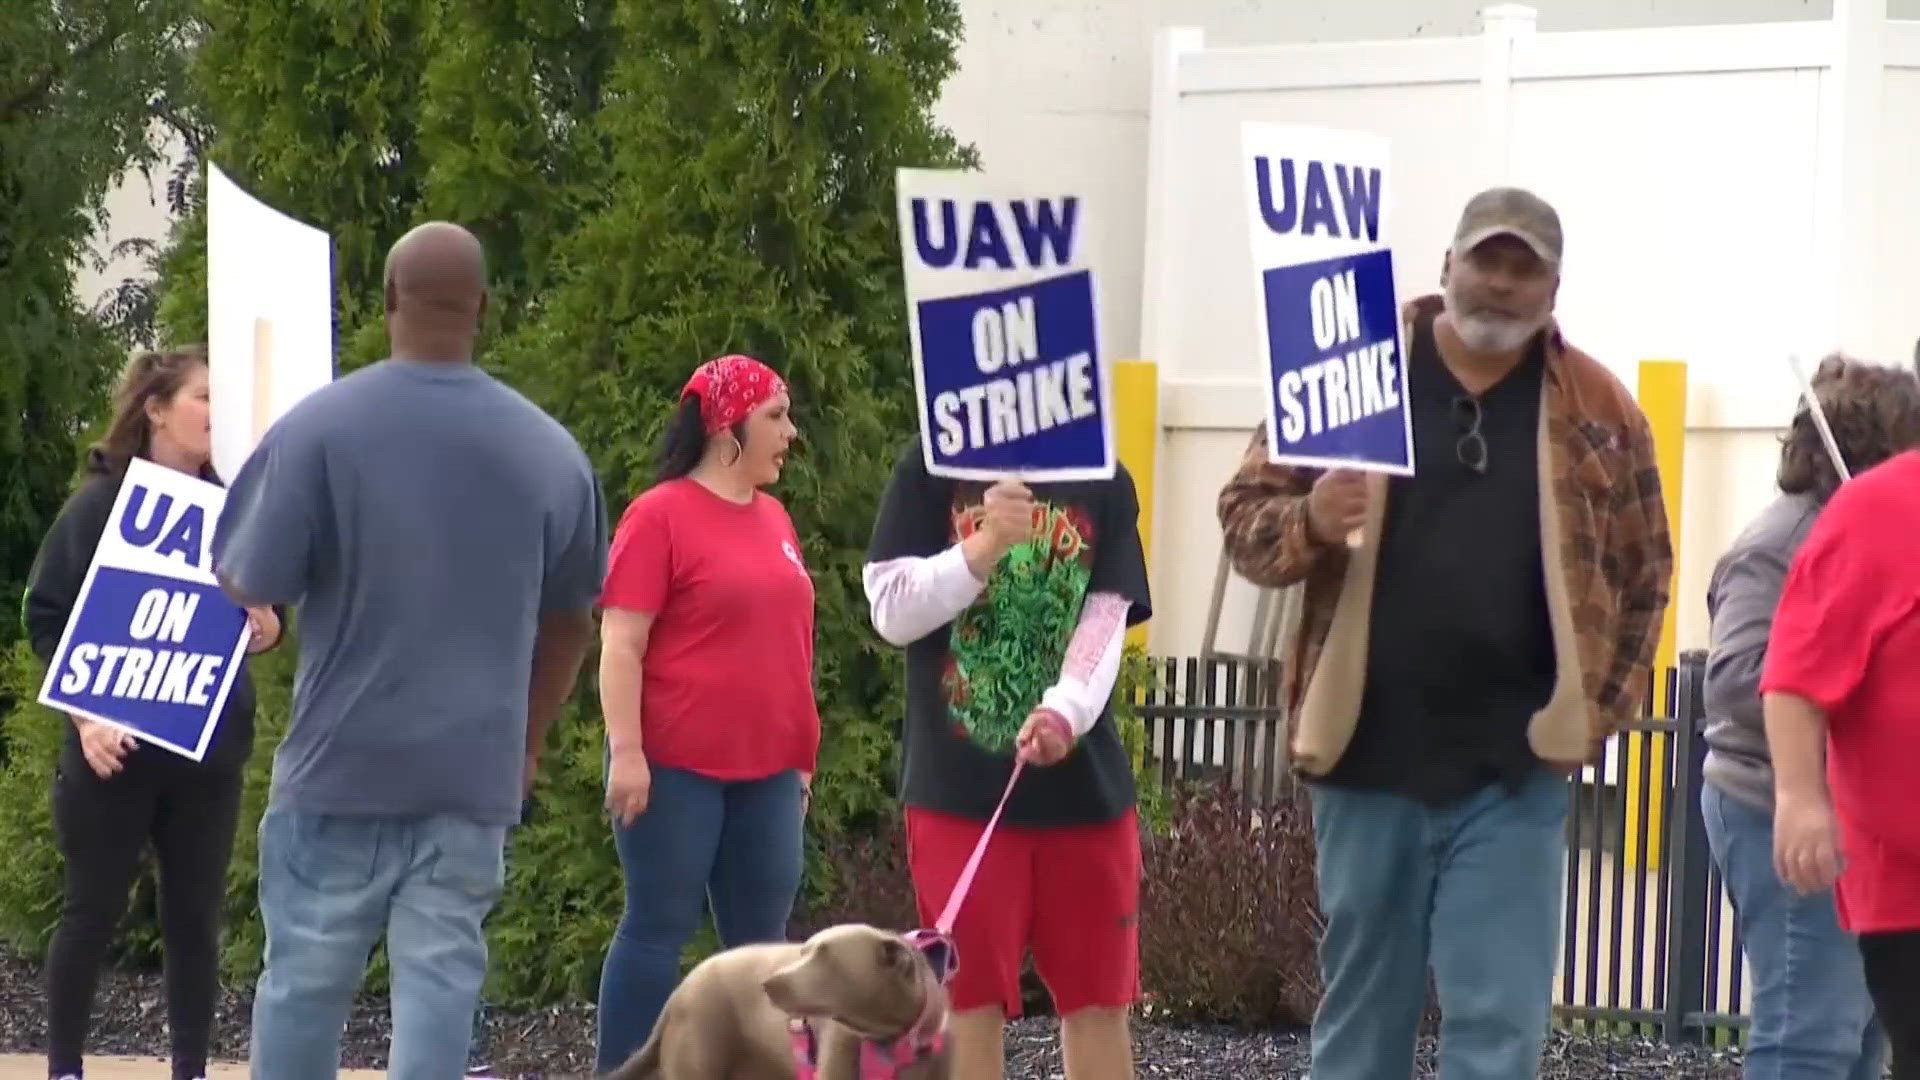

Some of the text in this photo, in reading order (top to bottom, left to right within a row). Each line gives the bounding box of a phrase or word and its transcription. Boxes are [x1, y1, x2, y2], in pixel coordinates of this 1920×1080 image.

[911, 197, 1080, 269] UAW
[1254, 156, 1382, 243] UAW
[972, 297, 1039, 374] ON
[1311, 270, 1361, 351] ON
[933, 351, 1097, 456] STRIKE
[1279, 338, 1401, 444] STRIKE
[119, 484, 204, 568] UA
[129, 588, 200, 643] ON
[60, 642, 223, 706] STRIKE
